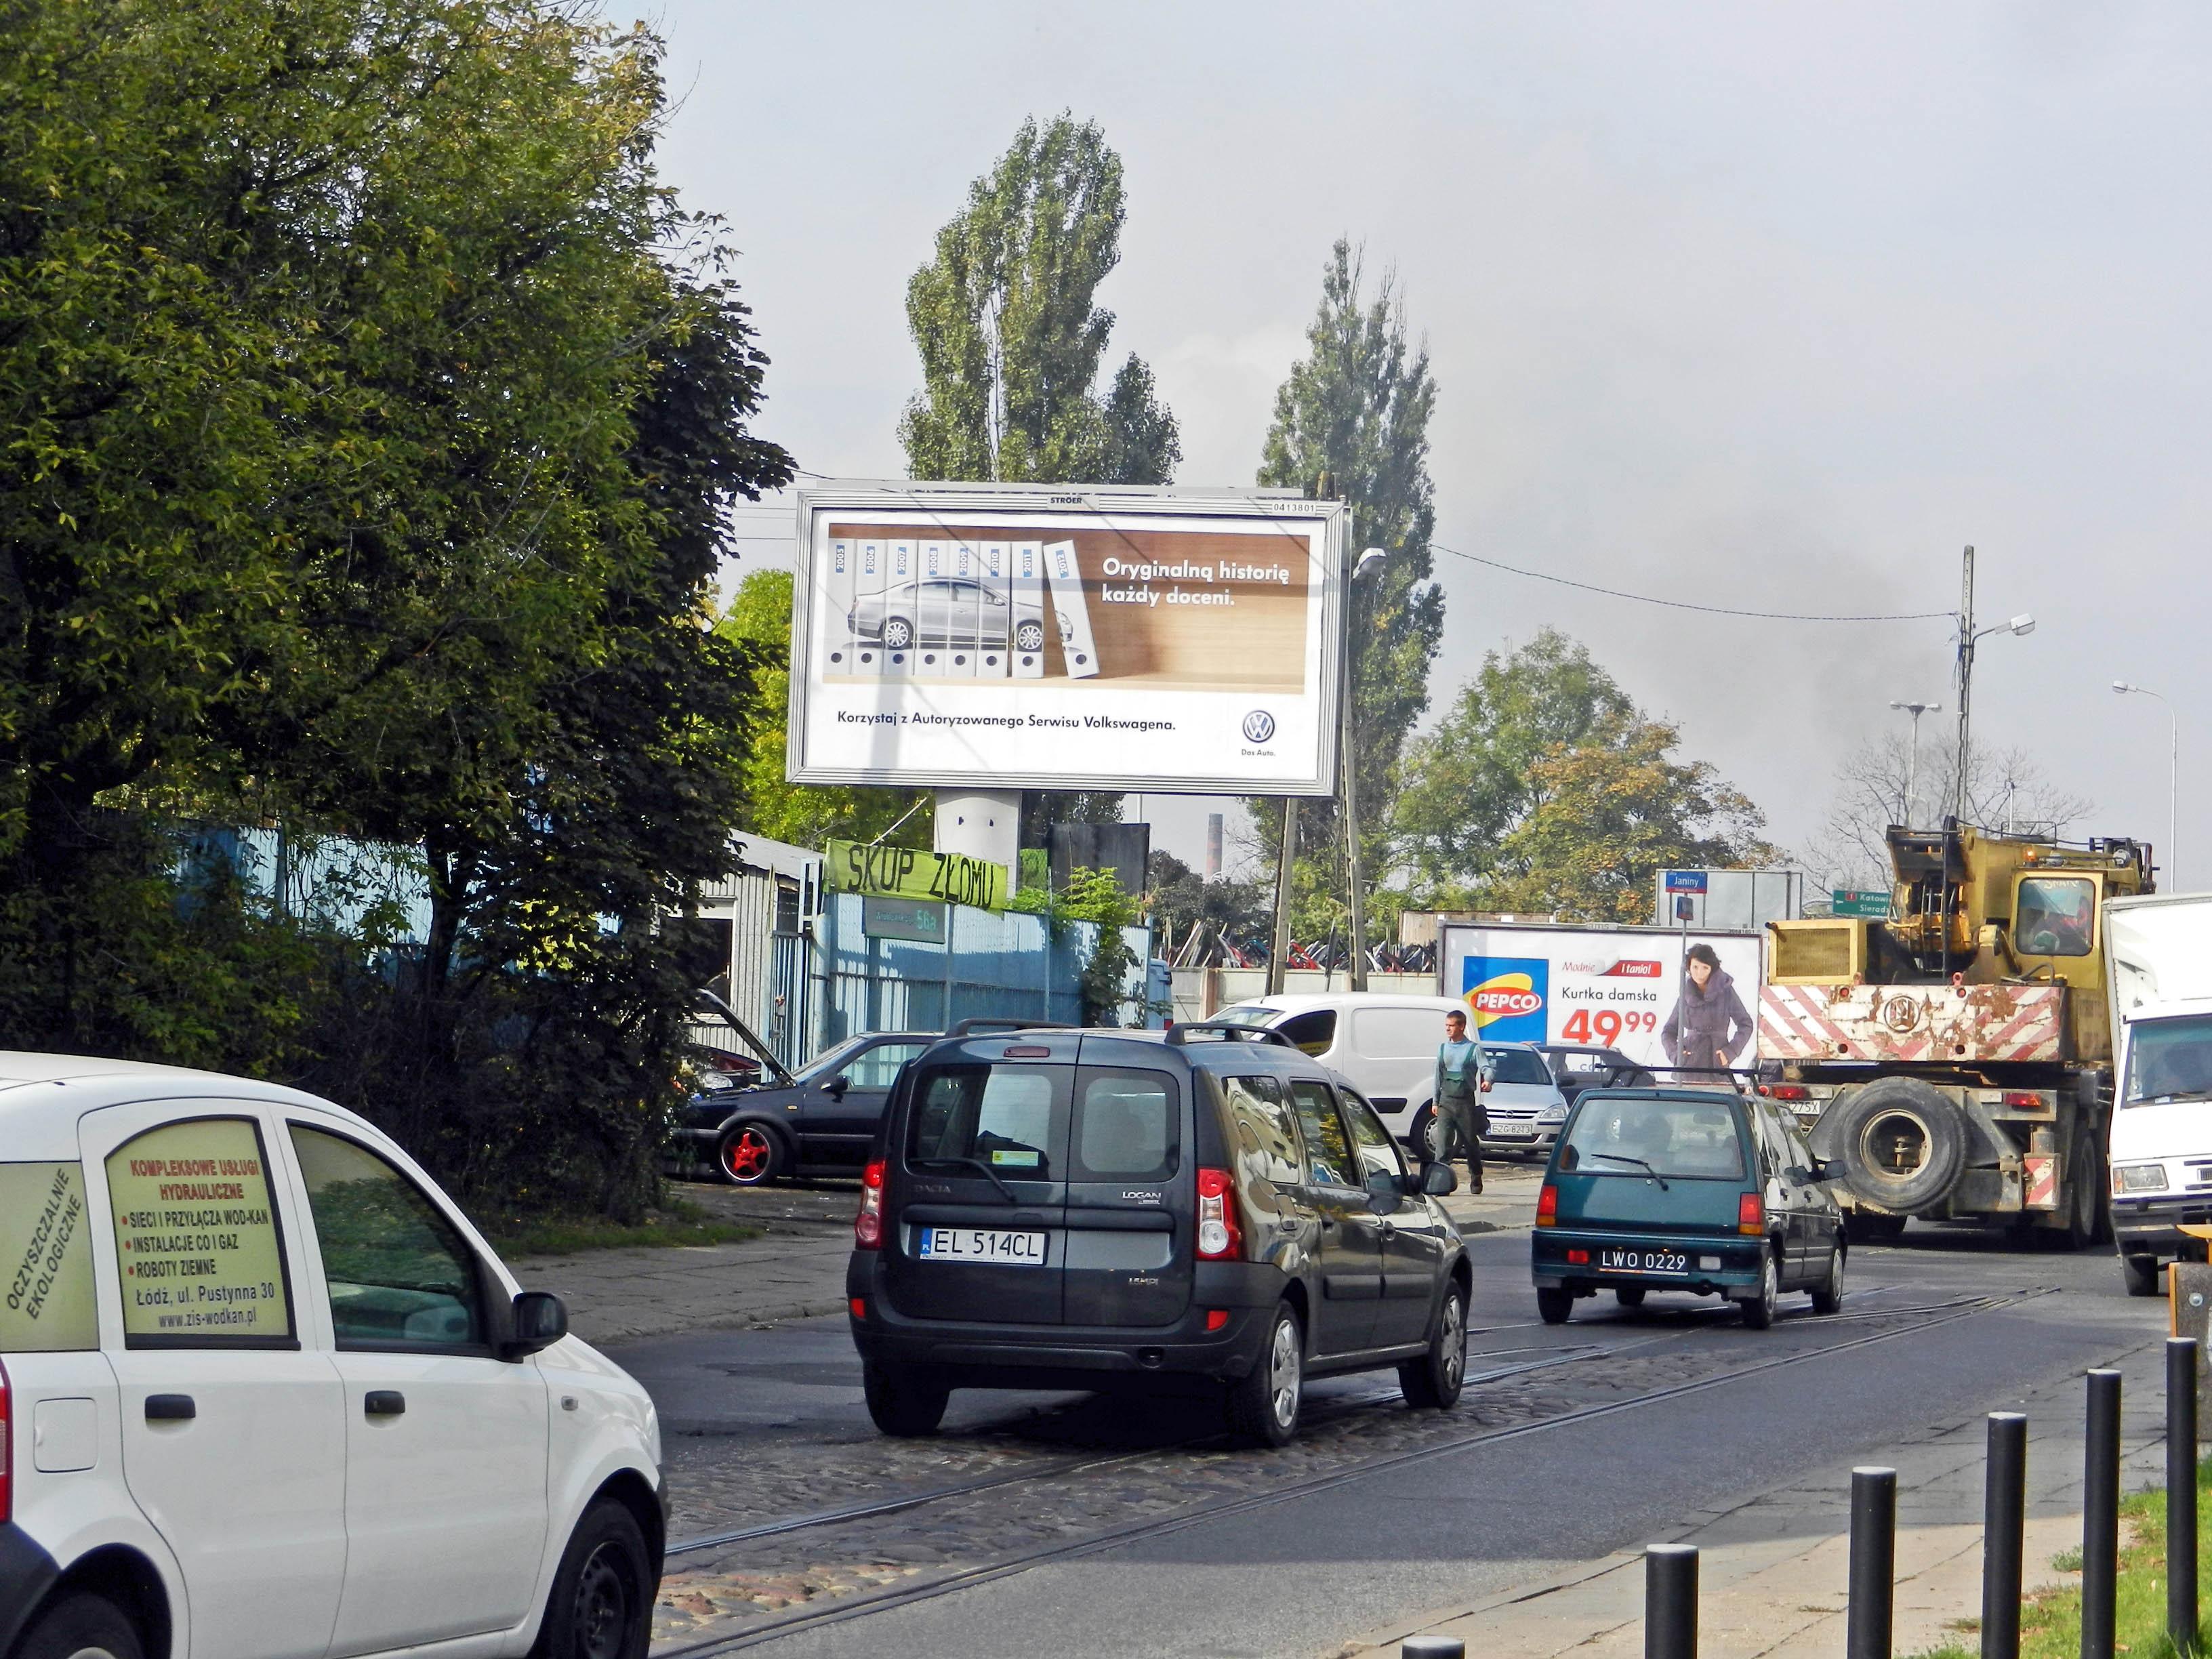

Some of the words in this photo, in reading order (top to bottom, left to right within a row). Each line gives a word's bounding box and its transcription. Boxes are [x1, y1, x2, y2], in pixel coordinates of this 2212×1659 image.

[1274, 504, 1314, 512] 0413801
[836, 547, 844, 572] 2005
[866, 548, 875, 573] 2006
[898, 549, 906, 573] 2007
[929, 550, 938, 573] 2008
[959, 550, 968, 574] 2009
[991, 551, 999, 573] 2010
[1023, 552, 1031, 574] 2011
[1057, 552, 1068, 576] 2012
[1103, 557, 1213, 582] Oryginalną
[1220, 560, 1290, 585] historię
[1102, 583, 1160, 607] każdy
[1166, 586, 1235, 605] doceni.
[838, 711, 897, 726] Korzystaj
[912, 712, 1024, 729] Autoryzowanego
[1028, 715, 1079, 727] Serwisu
[1084, 716, 1176, 731] Volkswagena.
[847, 844, 914, 893] SKUP
[929, 853, 994, 909] ZŁOMU
[1675, 876, 1699, 888] Janiny
[1860, 893, 1889, 903] Katowi
[1562, 962, 1595, 972] Modnie
[1476, 994, 1536, 1010] PEPCO
[1562, 987, 1603, 1000] Kurtka
[1609, 987, 1657, 1001] damska
[130, 1160, 216, 1176] KOMPLEKSOWE
[220, 1160, 259, 1176] USŁUGI
[159, 1183, 244, 1200] HYDRAULICZNE
[130, 1212, 157, 1228] SIECI
[165, 1210, 223, 1230] PRZYŁĄCZA
[224, 1209, 268, 1225] WOD-KAN
[7, 1167, 70, 1311] OCZYSZCZALNIE
[133, 1234, 194, 1252] INSTALACJE
[197, 1235, 210, 1250] CO
[218, 1233, 239, 1250] GAZ
[935, 1231, 963, 1253] EL
[973, 1232, 1038, 1256] 514CL
[26, 1194, 82, 1320] EKOLOGICZNE
[136, 1261, 177, 1278] ROBOTY
[180, 1258, 217, 1275] ZIEMNE
[1602, 1251, 1637, 1267] LWO
[1645, 1253, 1685, 1269] 0229
[136, 1288, 173, 1307] Łódź,
[178, 1286, 194, 1303] ul.
[199, 1284, 257, 1307] Pustynna
[261, 1282, 274, 1299] 30
[159, 1307, 257, 1328] www.zis-wodkan.pl
